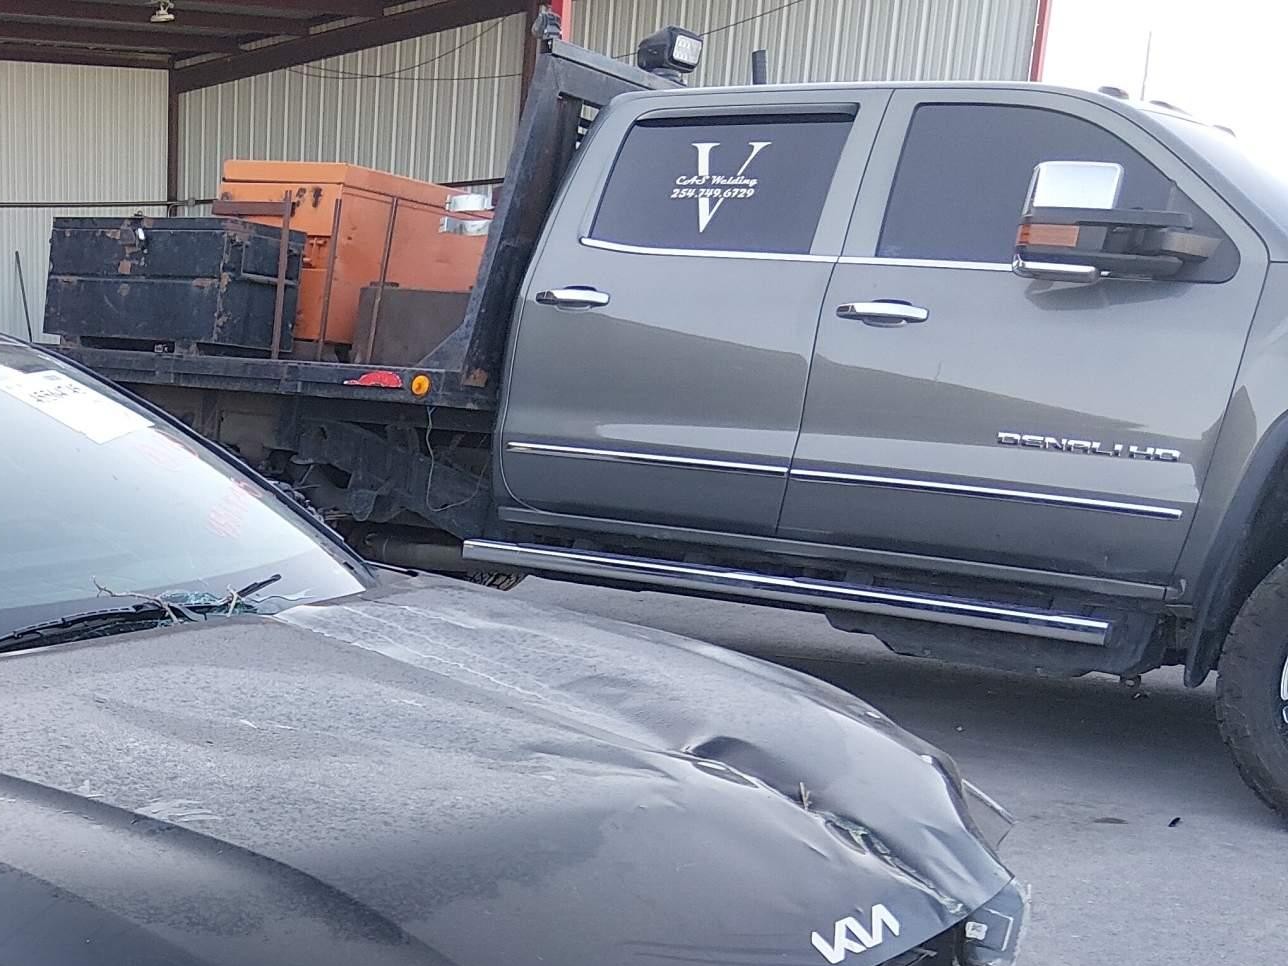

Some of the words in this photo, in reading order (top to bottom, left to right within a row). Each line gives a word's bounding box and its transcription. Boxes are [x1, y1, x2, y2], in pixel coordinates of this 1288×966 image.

[670, 188, 755, 199] 254.749.6729
[691, 141, 772, 233] V
[711, 175, 758, 187] Welding
[997, 431, 1123, 457] DENALI
[1127, 445, 1181, 462] HD
[811, 903, 900, 965] KIA
